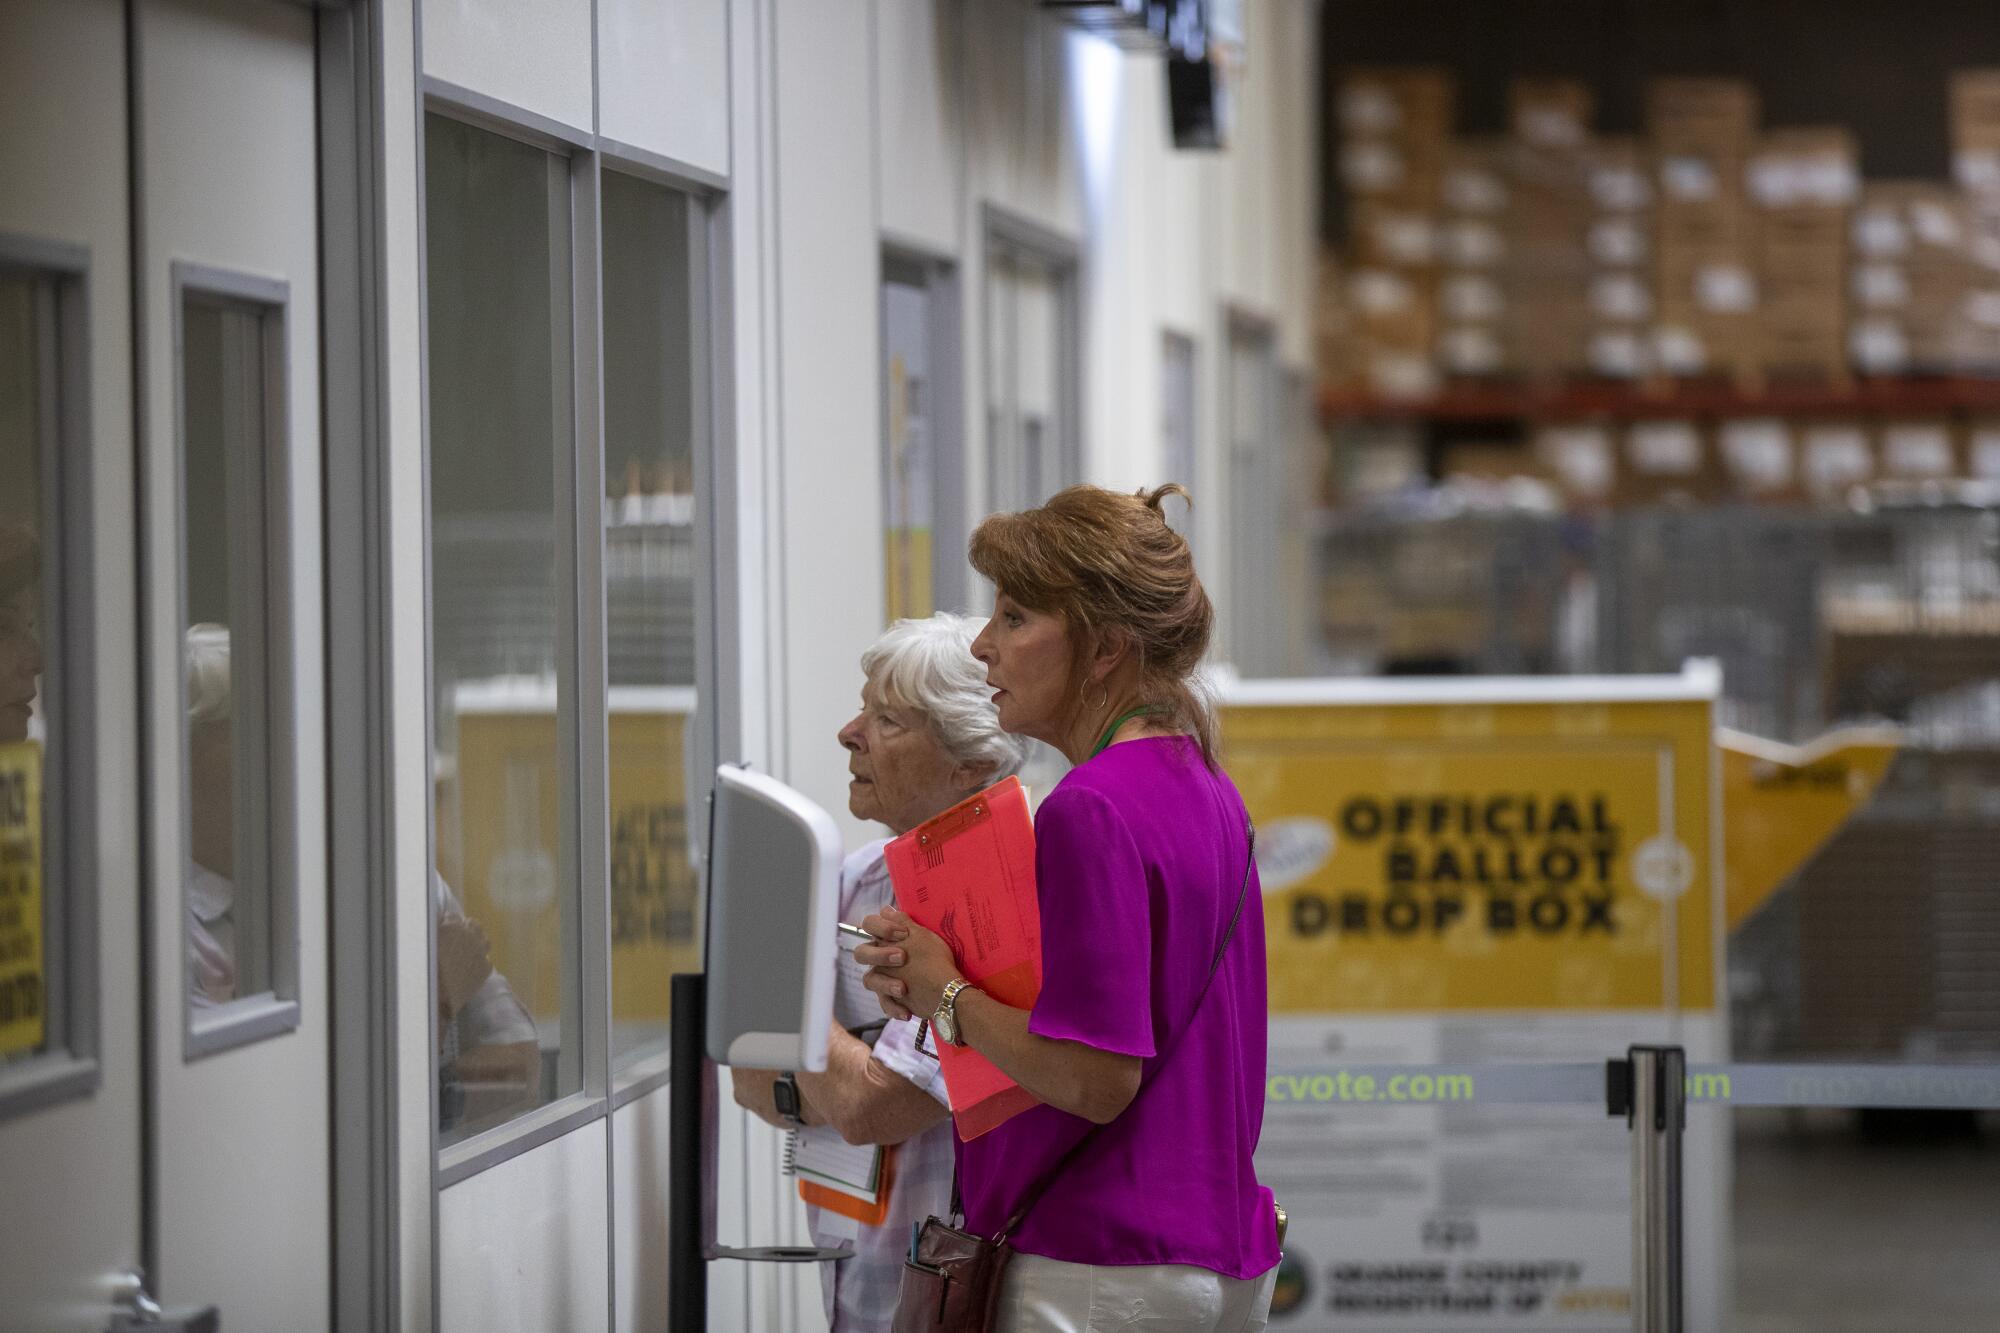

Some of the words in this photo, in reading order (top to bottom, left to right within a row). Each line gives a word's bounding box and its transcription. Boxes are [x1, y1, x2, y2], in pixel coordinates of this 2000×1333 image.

[1341, 796, 1616, 841] OFFICIAL
[1386, 842, 1617, 884] BALLOT
[1291, 894, 1466, 936] DROP
[1487, 893, 1617, 936] BOX
[1268, 1071, 1473, 1101] cvote.com
